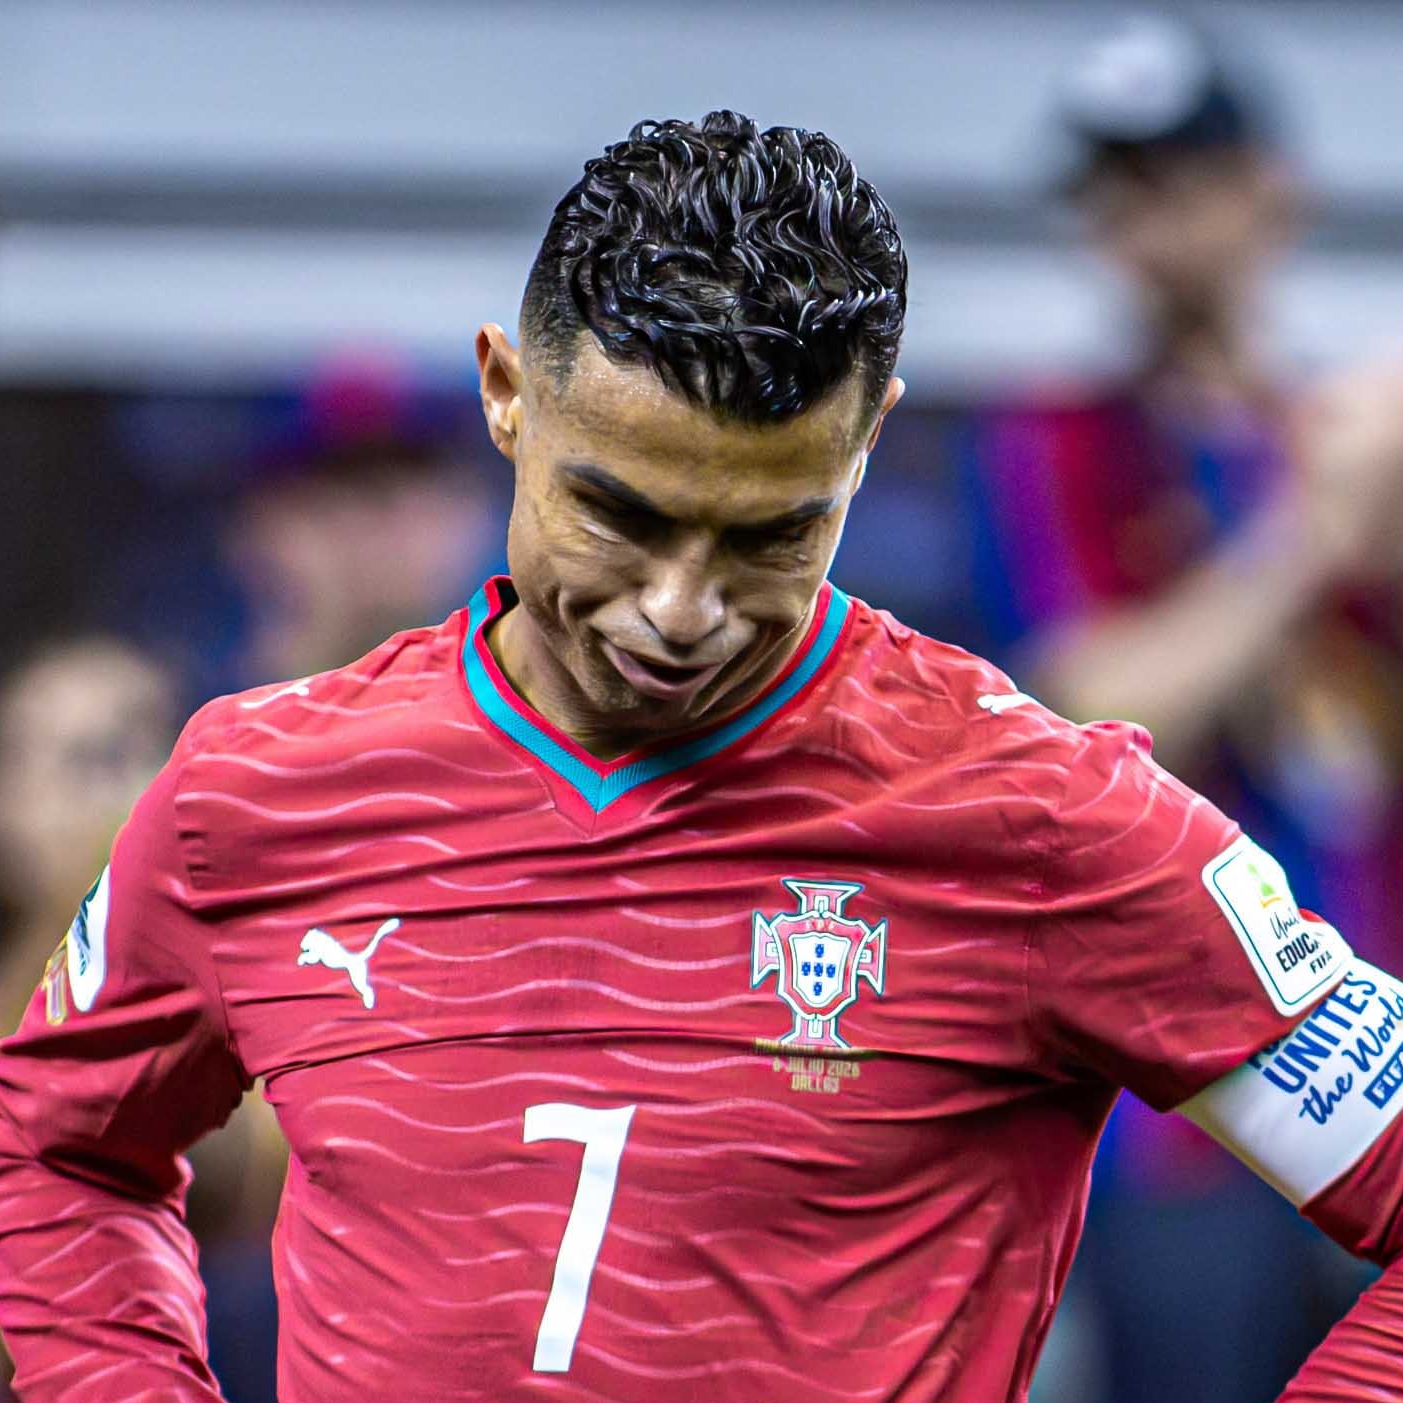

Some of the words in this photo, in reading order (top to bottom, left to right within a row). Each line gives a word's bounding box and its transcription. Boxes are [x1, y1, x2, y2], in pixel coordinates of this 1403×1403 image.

[1262, 970, 1378, 1094] UNITES
[1299, 1073, 1354, 1125] the
[523, 1103, 637, 1372] 7
